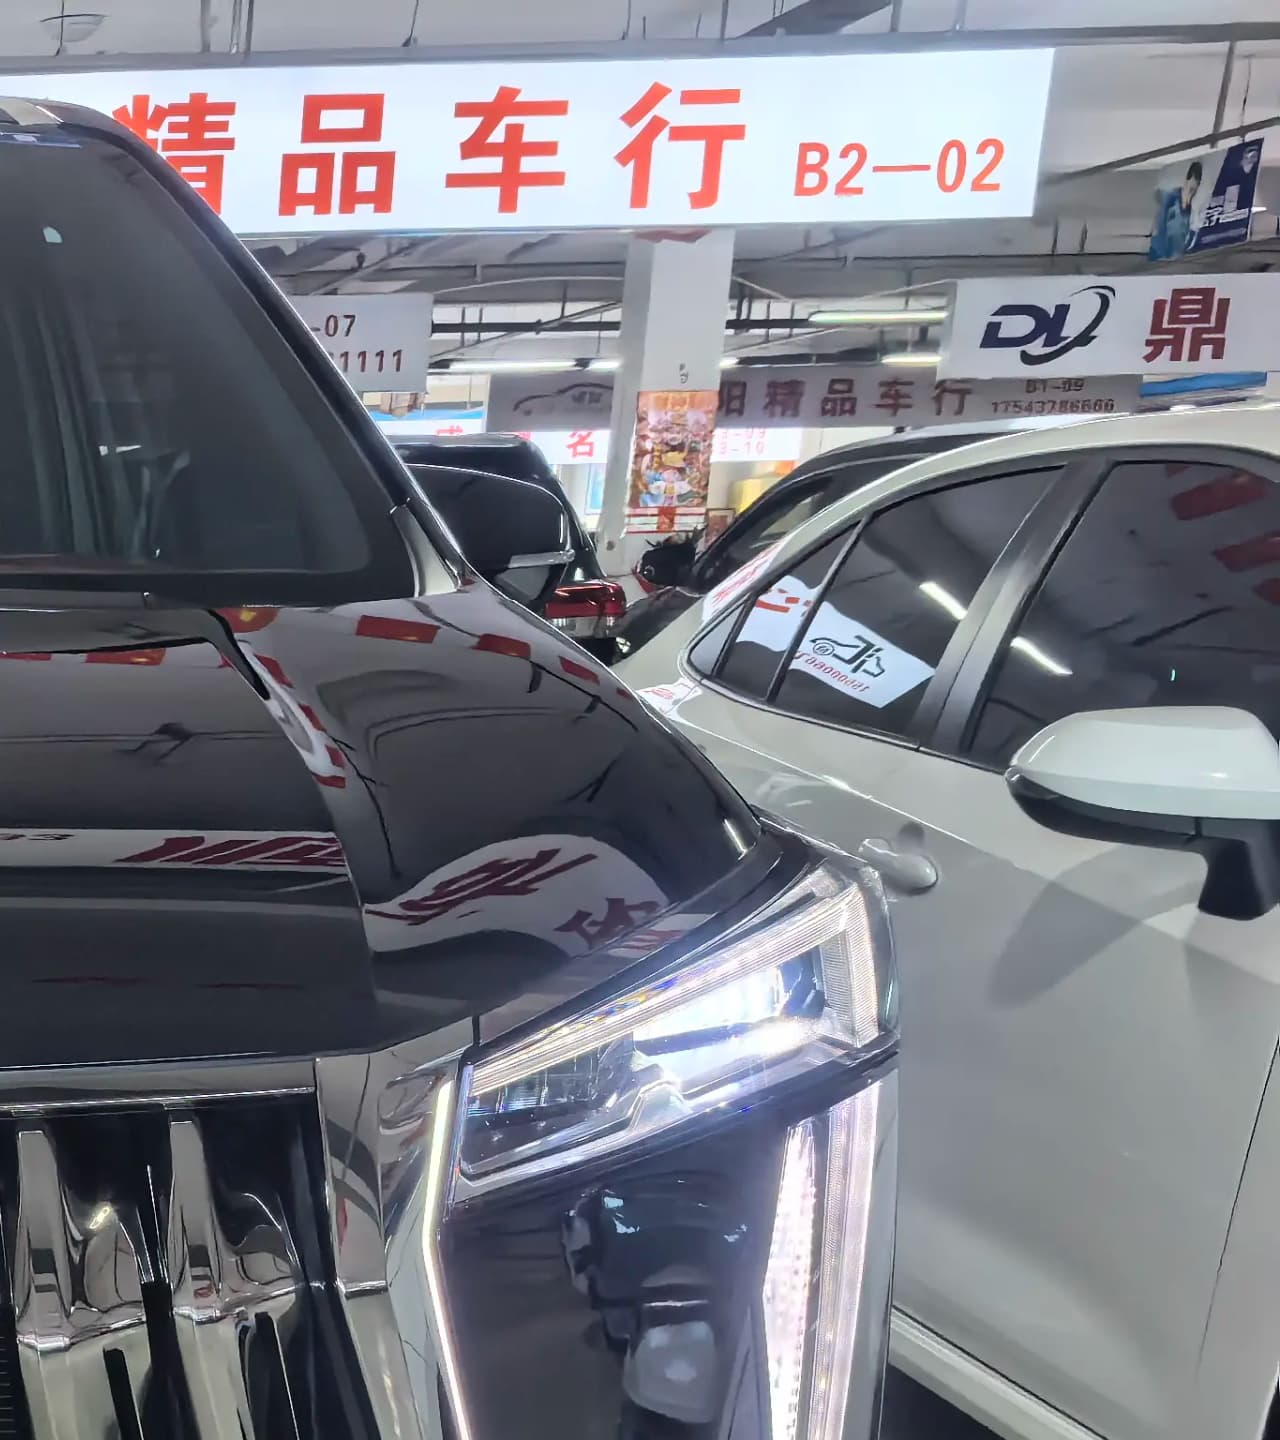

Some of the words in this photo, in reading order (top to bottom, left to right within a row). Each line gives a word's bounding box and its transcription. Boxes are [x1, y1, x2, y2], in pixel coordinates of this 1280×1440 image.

[112, 81, 746, 216] 精品车行
[329, 349, 403, 373] 1111
[1142, 287, 1231, 363] 鼎
